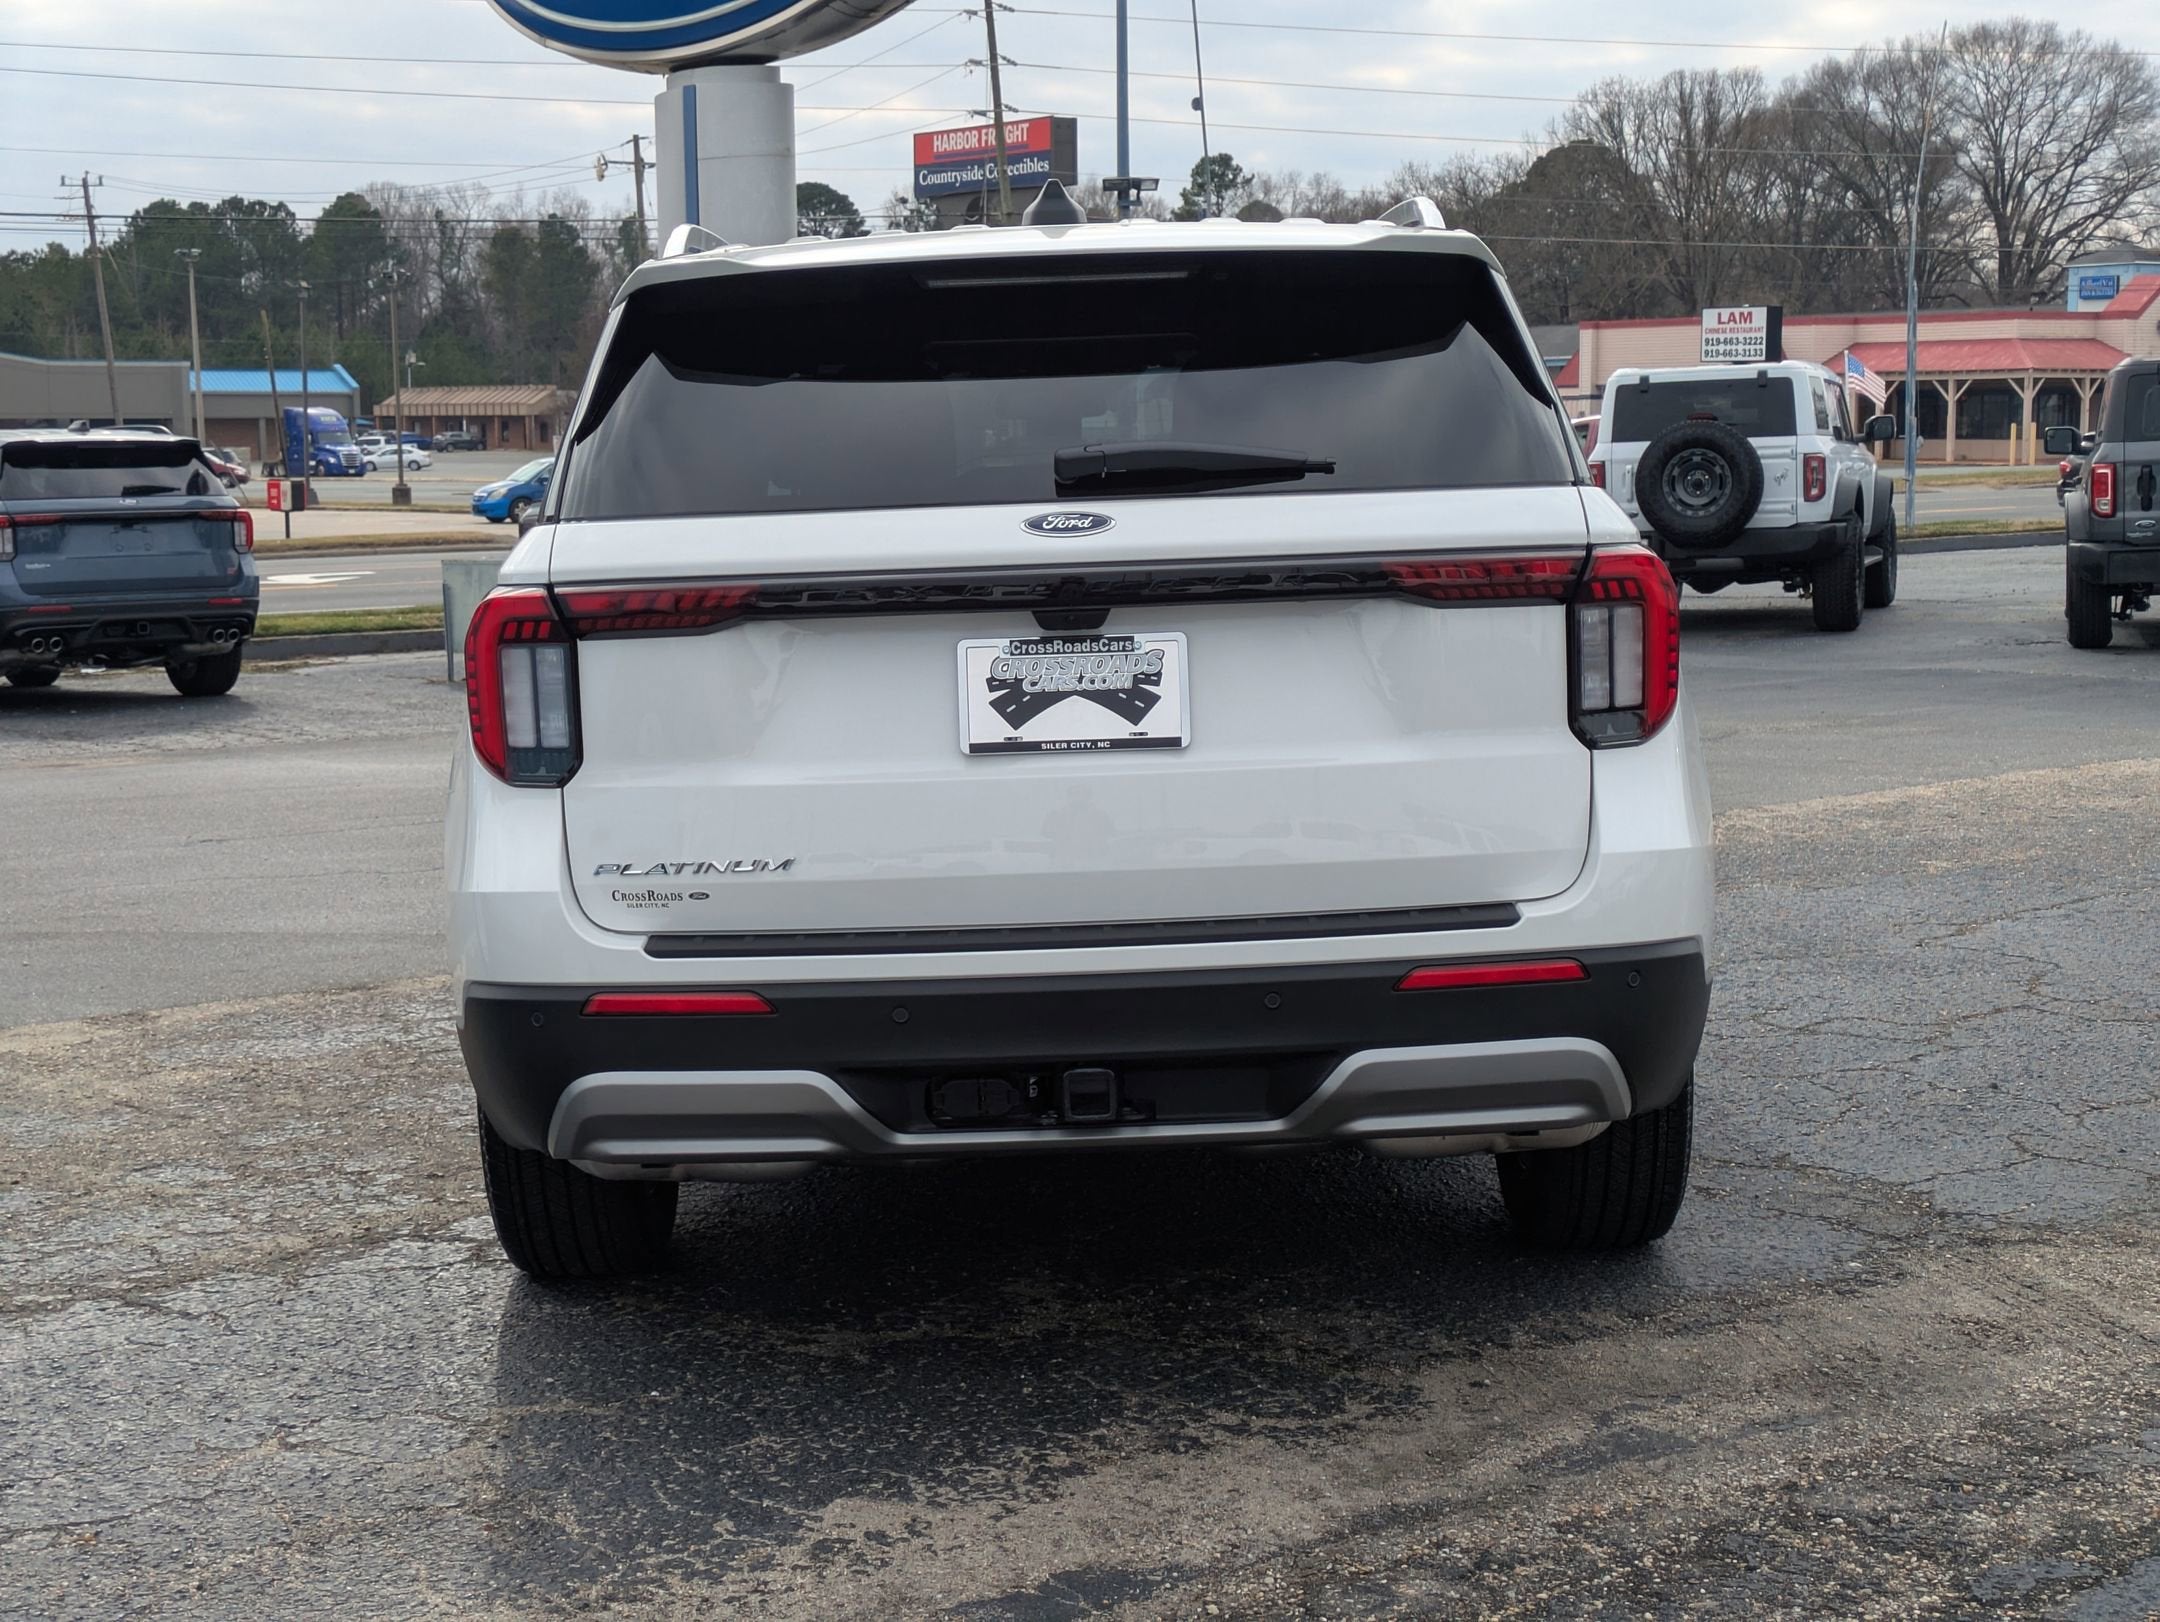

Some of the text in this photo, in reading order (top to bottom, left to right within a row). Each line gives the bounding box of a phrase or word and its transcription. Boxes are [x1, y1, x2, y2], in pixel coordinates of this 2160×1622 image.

[933, 122, 1029, 153] HARBOR FRGHT
[919, 164, 984, 187] Countryside
[1717, 311, 1753, 325] LAM
[1704, 326, 1764, 335] CHINESE RESTAURANT
[1704, 336, 1764, 347] 919-663-3222
[1703, 348, 1763, 358] 919-663-3133
[1042, 514, 1094, 529] Ford
[1011, 639, 1133, 655] CrossRoadsCars
[990, 649, 1165, 680] CROSSROADS
[1022, 673, 1134, 693] CARS.COM
[1041, 741, 1111, 750] SILER CITY, NC
[593, 857, 796, 876] PLATINUM
